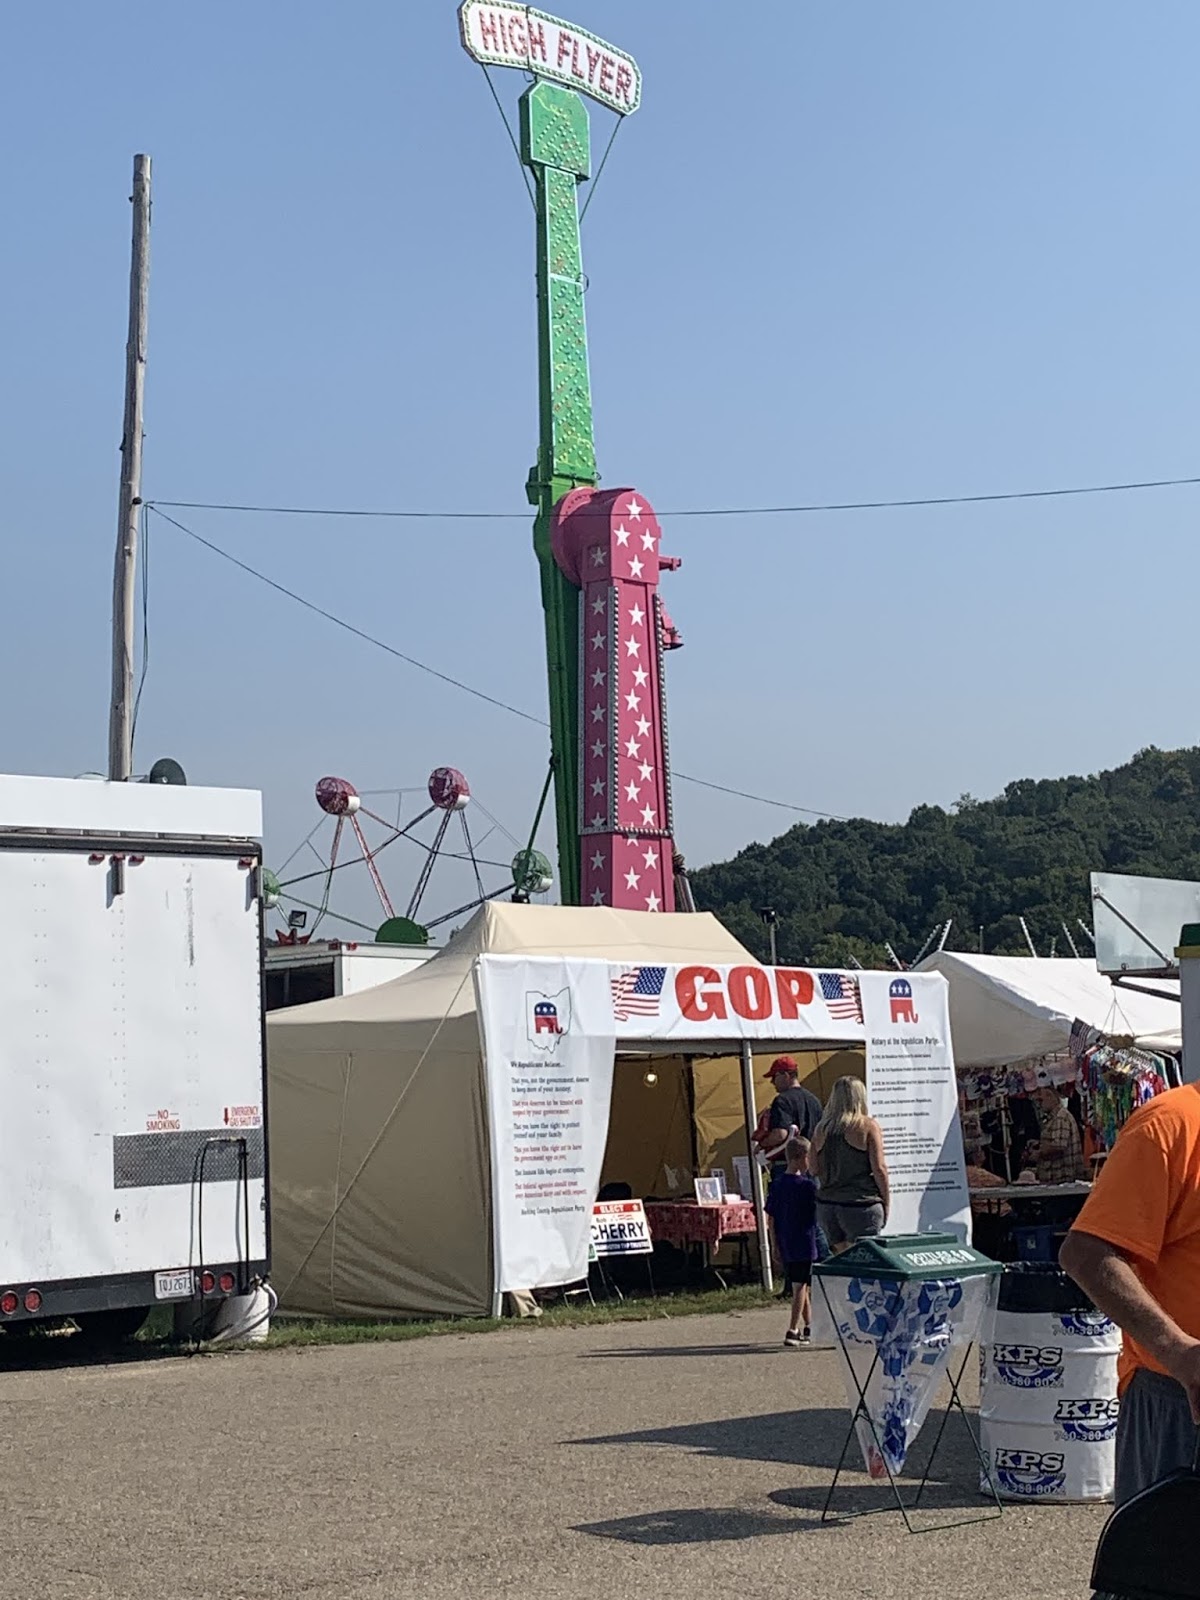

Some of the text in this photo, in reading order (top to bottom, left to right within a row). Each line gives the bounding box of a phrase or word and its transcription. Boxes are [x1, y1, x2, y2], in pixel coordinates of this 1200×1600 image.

[479, 10, 632, 104] HIGH FLYER
[675, 966, 814, 1021] GOP
[146, 1119, 180, 1130] SMOKING
[157, 1110, 168, 1119] NO
[600, 1204, 624, 1214] ELECT
[590, 1222, 644, 1240] CHERRY
[994, 1344, 1063, 1366] KPS
[1054, 1398, 1120, 1421] KPS
[996, 1448, 1064, 1474] KPS
